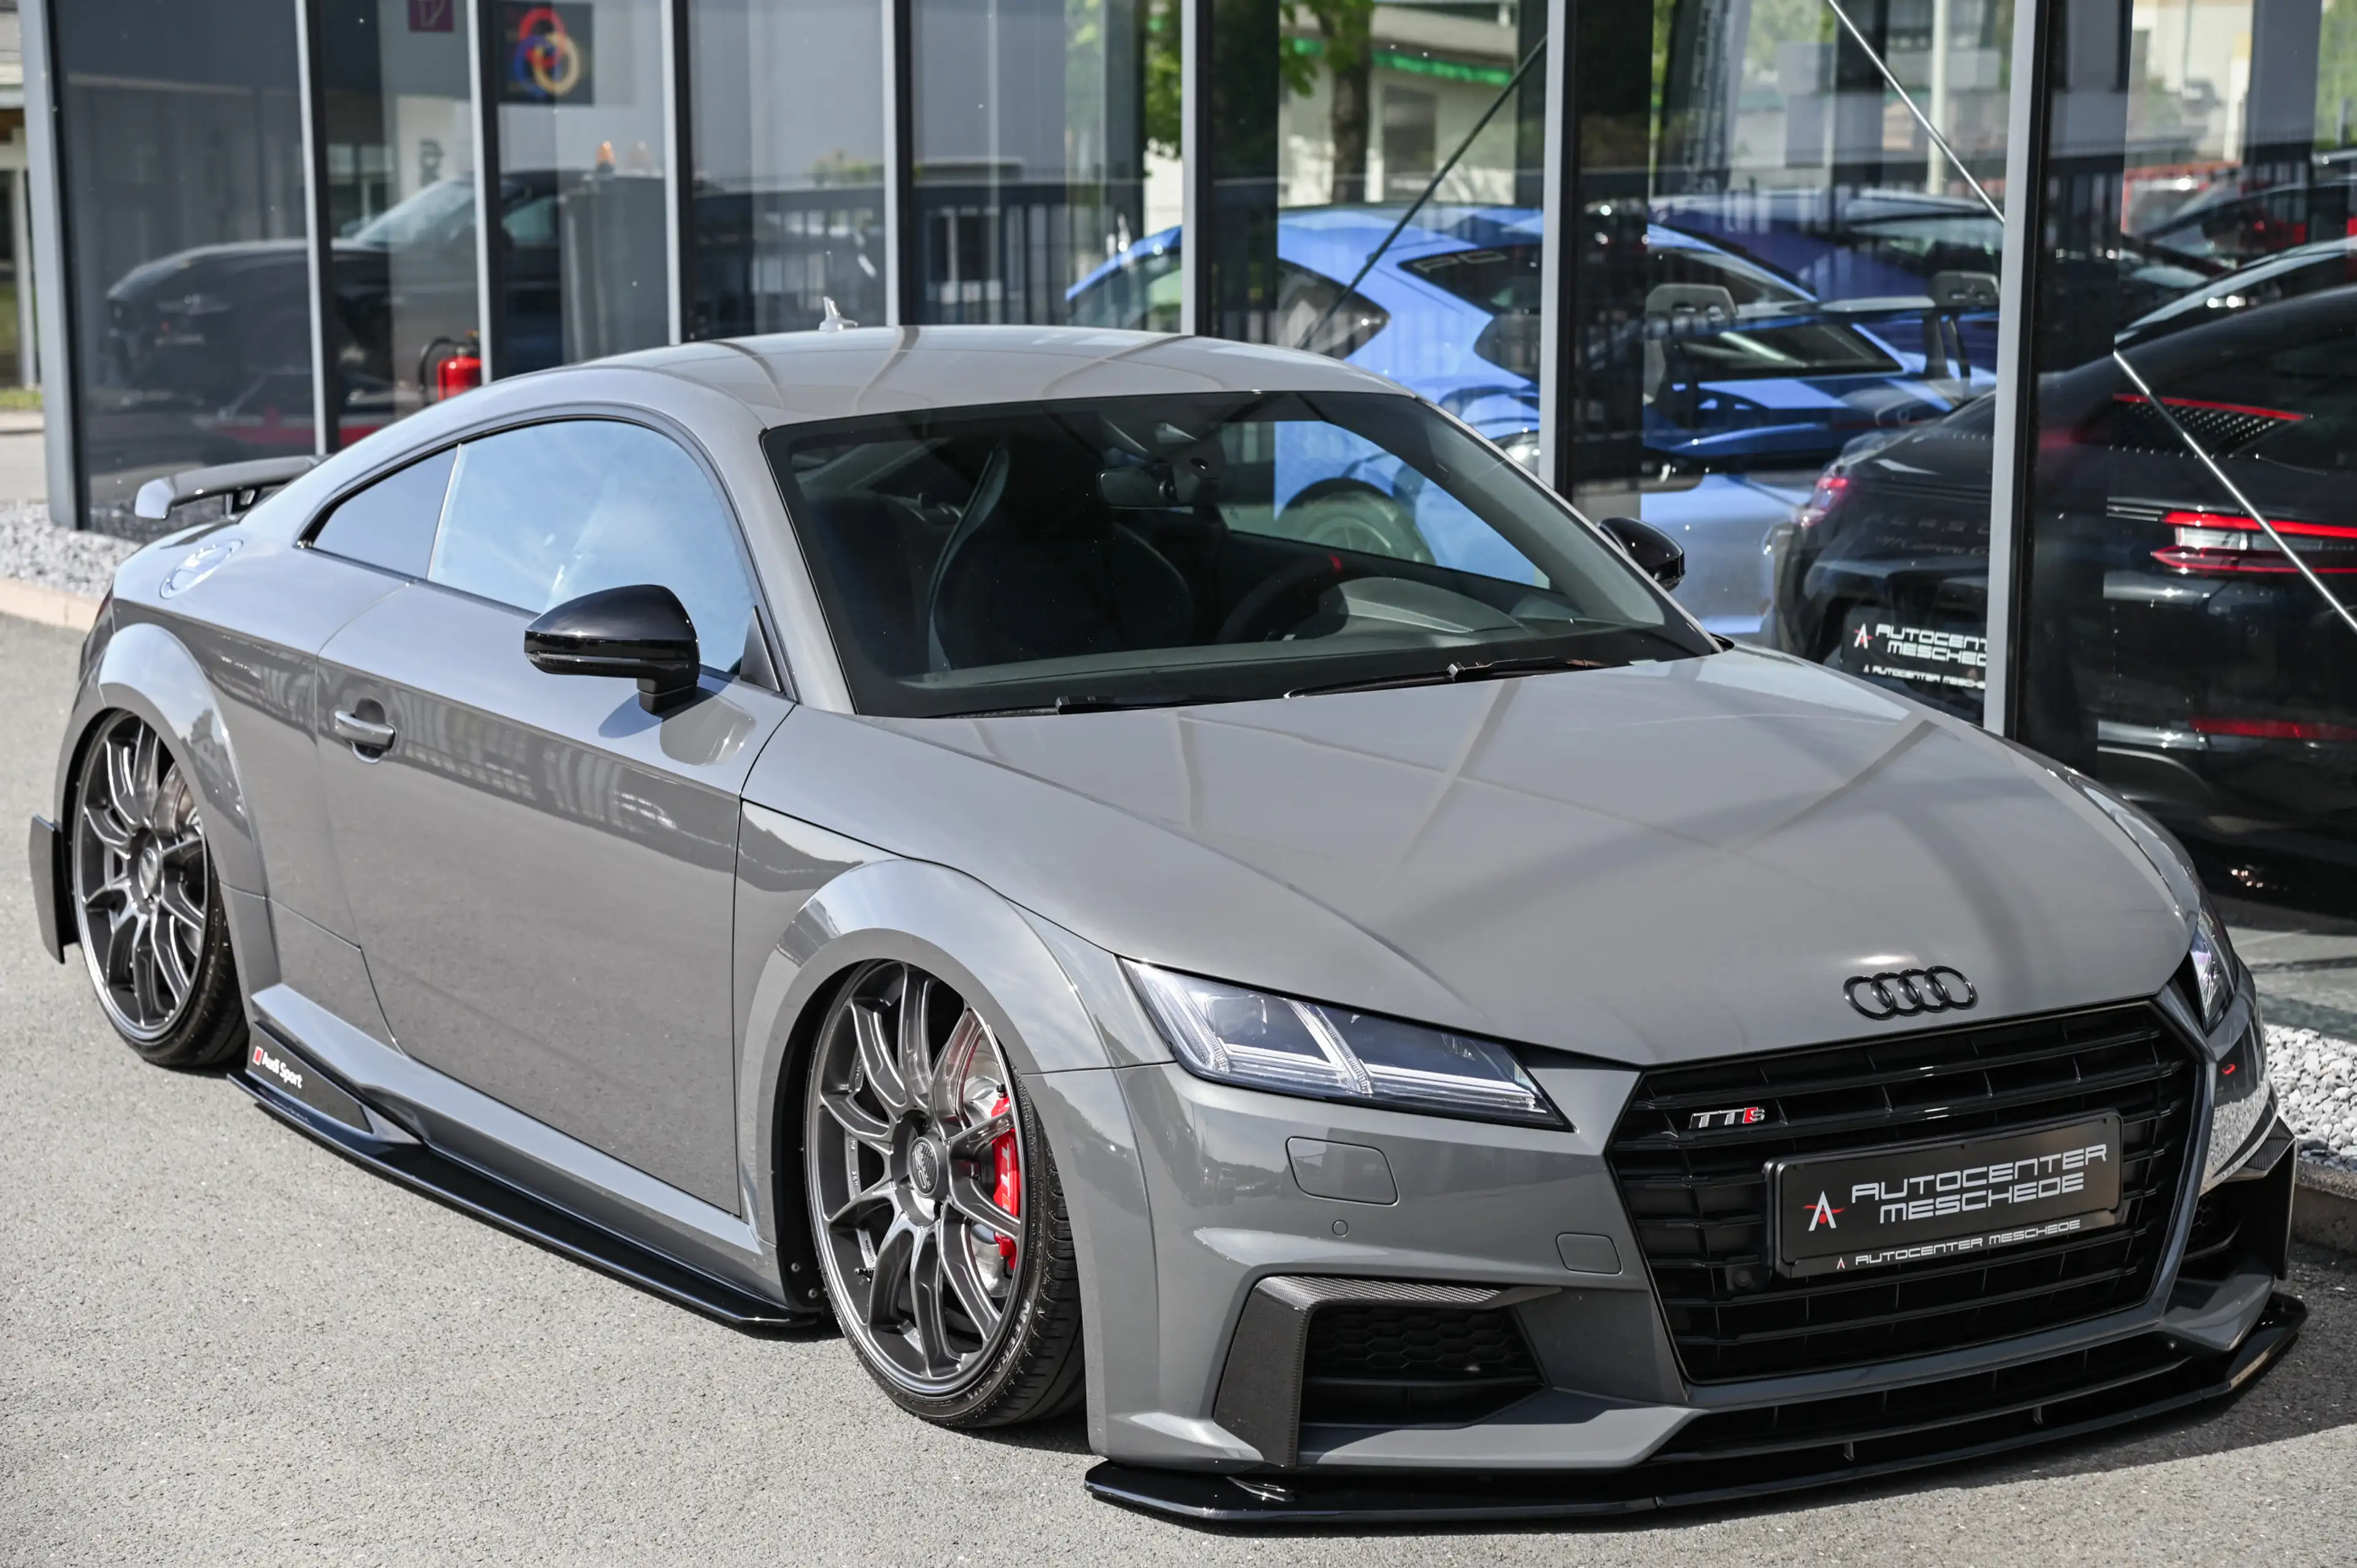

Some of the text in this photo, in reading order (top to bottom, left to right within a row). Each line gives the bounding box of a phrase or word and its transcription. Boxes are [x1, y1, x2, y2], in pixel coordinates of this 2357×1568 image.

[1872, 665, 1941, 682] AUTOCENTER
[261, 1051, 303, 1089] Audi Sport
[1689, 1106, 1766, 1130] TTS
[1851, 1143, 2107, 1204] AUTOCENTER
[1879, 1172, 2084, 1224] MESCHEDE
[1855, 1219, 2081, 1265] AUTOCENTER MESCHEDE
